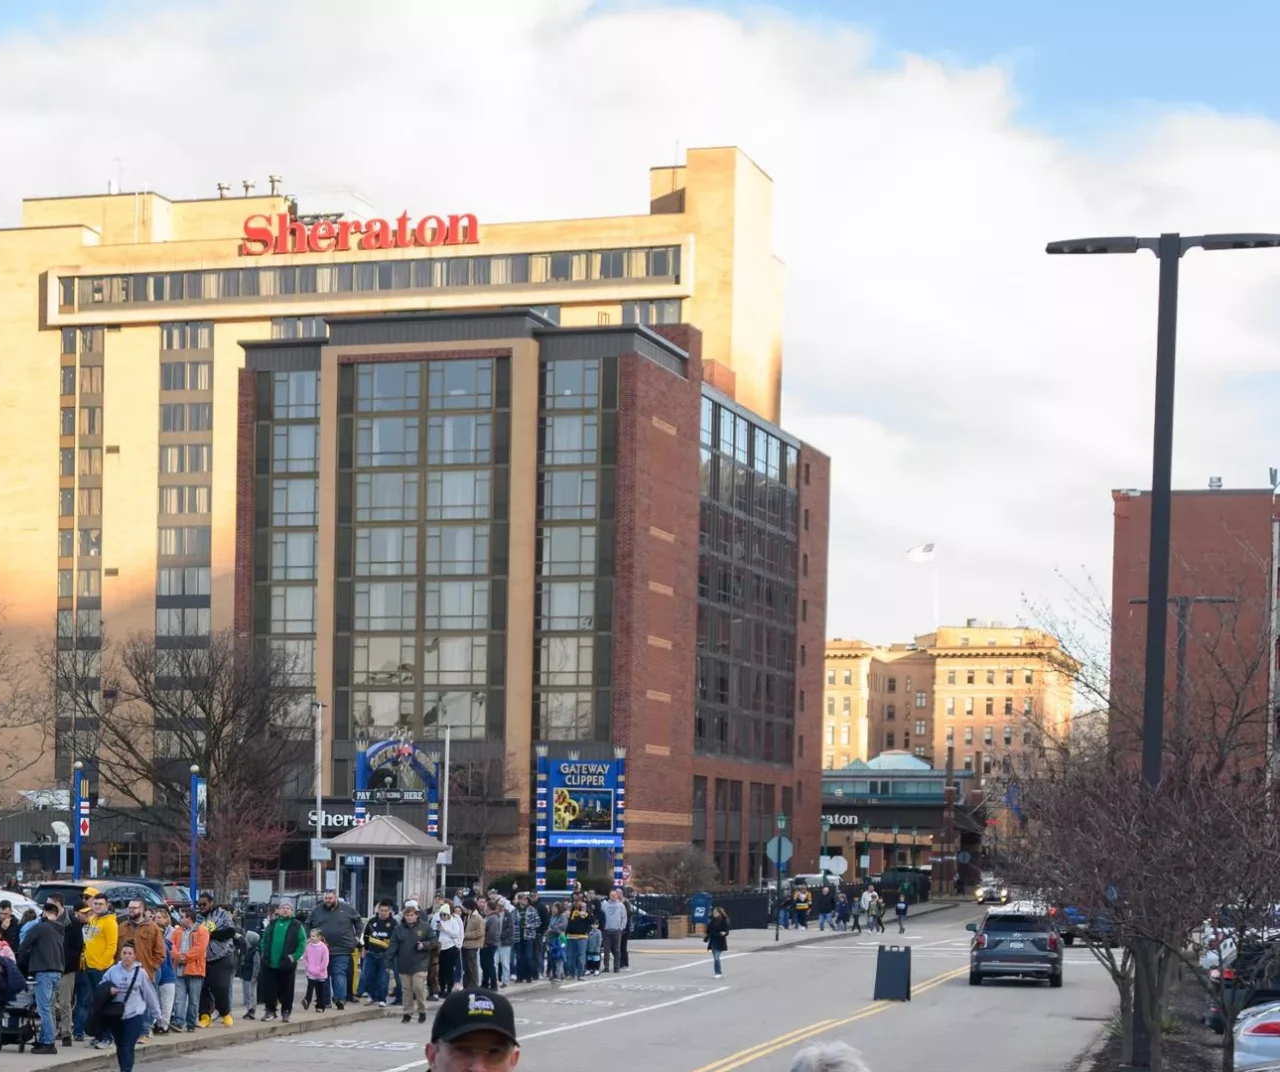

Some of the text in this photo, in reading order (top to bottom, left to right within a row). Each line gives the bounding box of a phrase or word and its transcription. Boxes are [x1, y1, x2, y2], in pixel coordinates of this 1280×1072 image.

[241, 209, 479, 256] Sheraton
[560, 763, 610, 774] GATEWAY
[565, 775, 605, 786] CLIPPER
[356, 791, 370, 799] PAY
[404, 791, 423, 799] HERE
